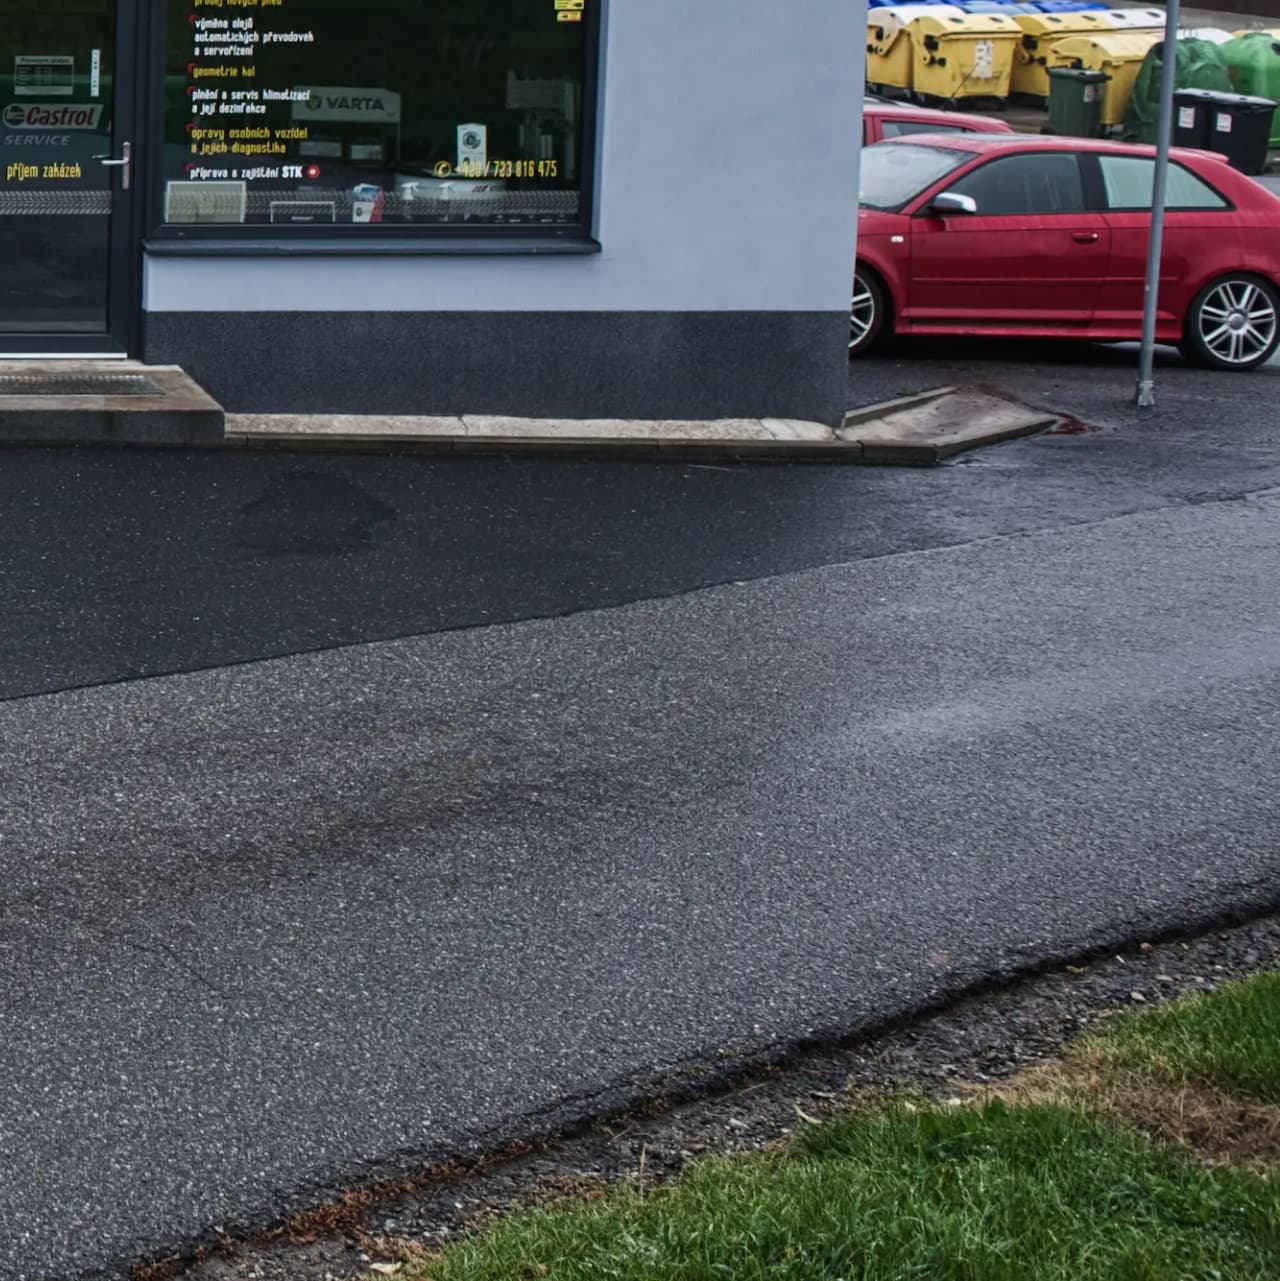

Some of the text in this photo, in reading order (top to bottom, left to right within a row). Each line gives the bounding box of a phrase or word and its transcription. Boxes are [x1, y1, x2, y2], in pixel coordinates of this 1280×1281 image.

[195, 17, 253, 30] výměna olejů
[194, 30, 314, 44] automatických převodovek
[194, 45, 254, 56] a servořízení
[193, 66, 256, 78] geometrie kol
[192, 88, 311, 101] plnění a servis klimatizací
[192, 102, 266, 115] a její dezinfekce
[326, 97, 385, 111] VARTA
[27, 107, 96, 126] Castrol
[4, 135, 71, 145] SERVICE
[191, 127, 308, 140] opravy osobních vozidel
[191, 143, 286, 155] a jejich diagnostika
[6, 162, 81, 181] příjem zakázek
[190, 165, 303, 179] příprava a zajištění STK
[494, 160, 512, 177] 723
[516, 160, 535, 177] 816
[538, 160, 558, 177] 475
